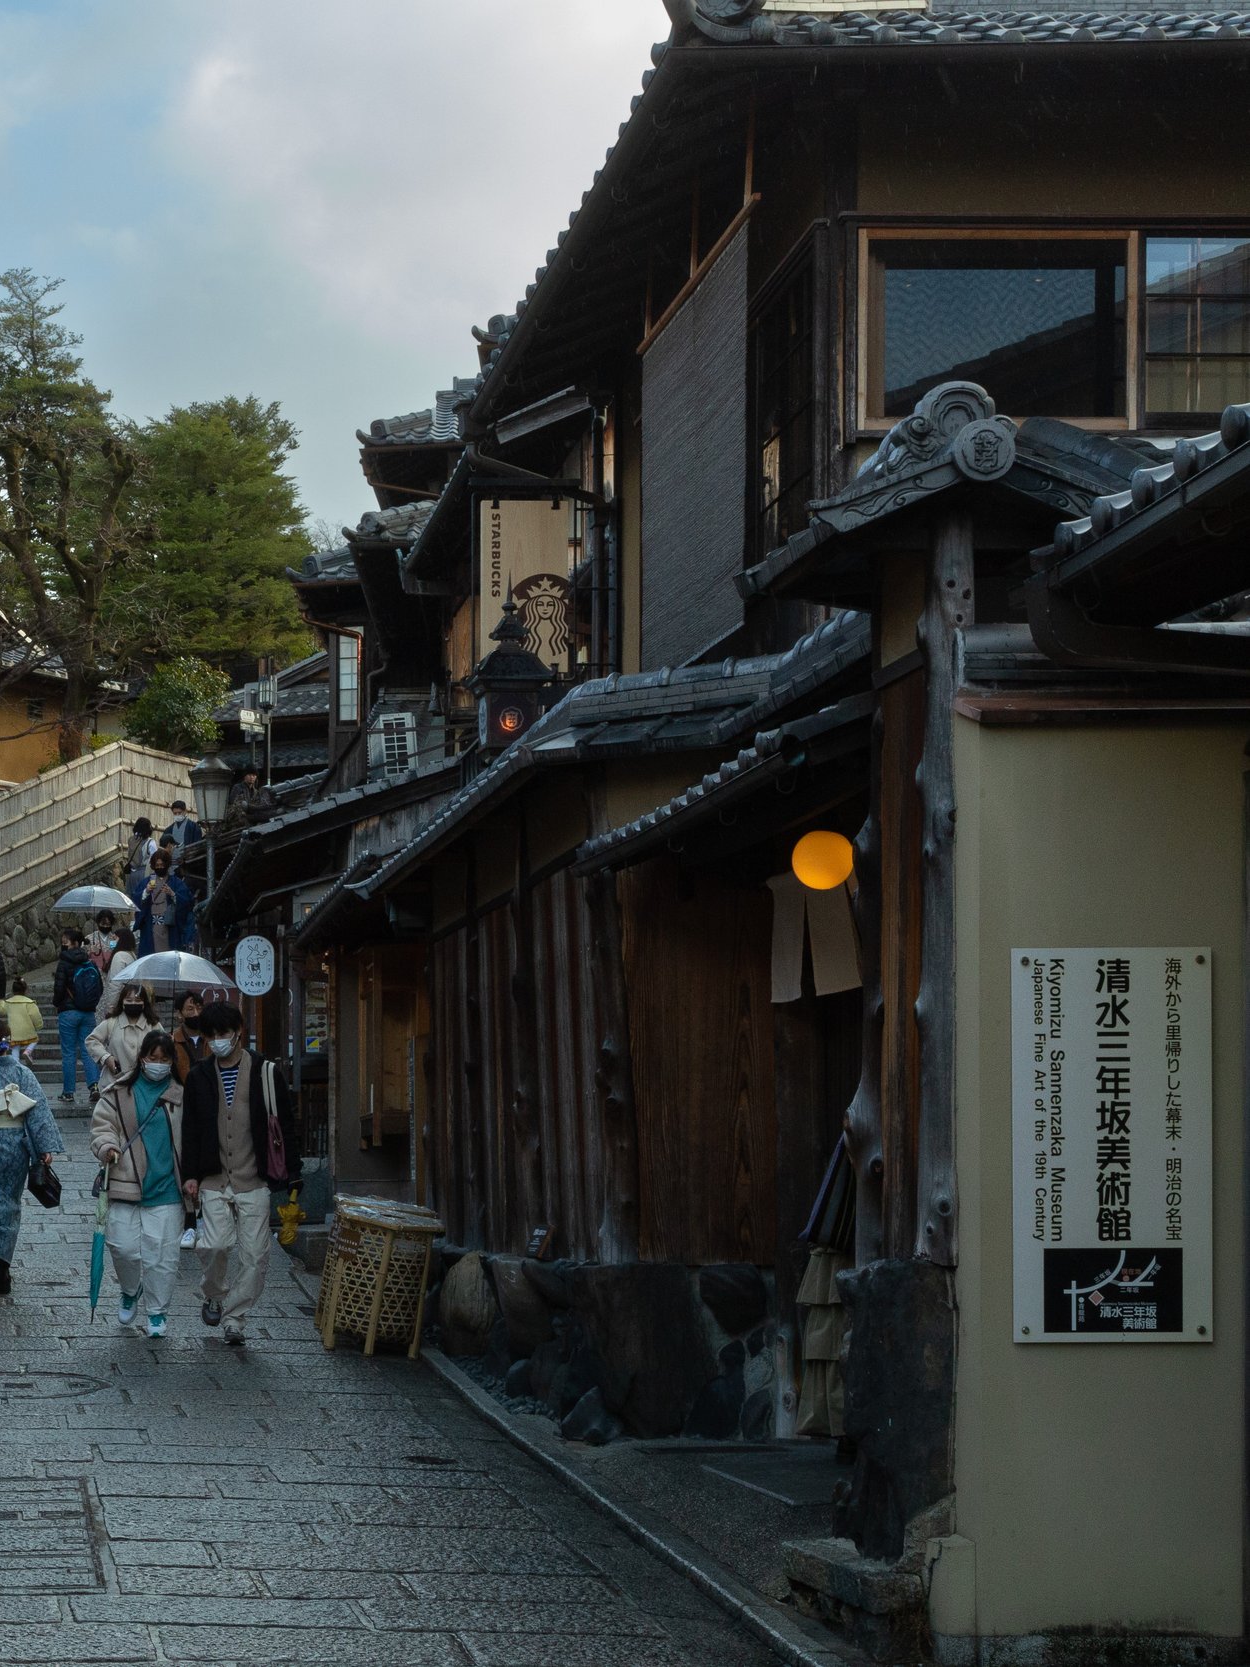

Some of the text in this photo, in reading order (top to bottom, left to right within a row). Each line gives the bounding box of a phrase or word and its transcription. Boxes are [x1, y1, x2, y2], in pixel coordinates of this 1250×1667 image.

[491, 513, 500, 598] STARBUCKS
[1031, 959, 1047, 1241] Japanese Fine Art of the 19th Century
[1046, 959, 1065, 1241] Kiyomizu Sannenzaka Museum
[1096, 958, 1131, 1241] 清水三年坂美術館
[1165, 958, 1182, 1240] 海外から里帰りした幕末・明治の名宝
[1099, 1306, 1157, 1318] 清水三年坂
[1122, 1318, 1158, 1330] 美術館
